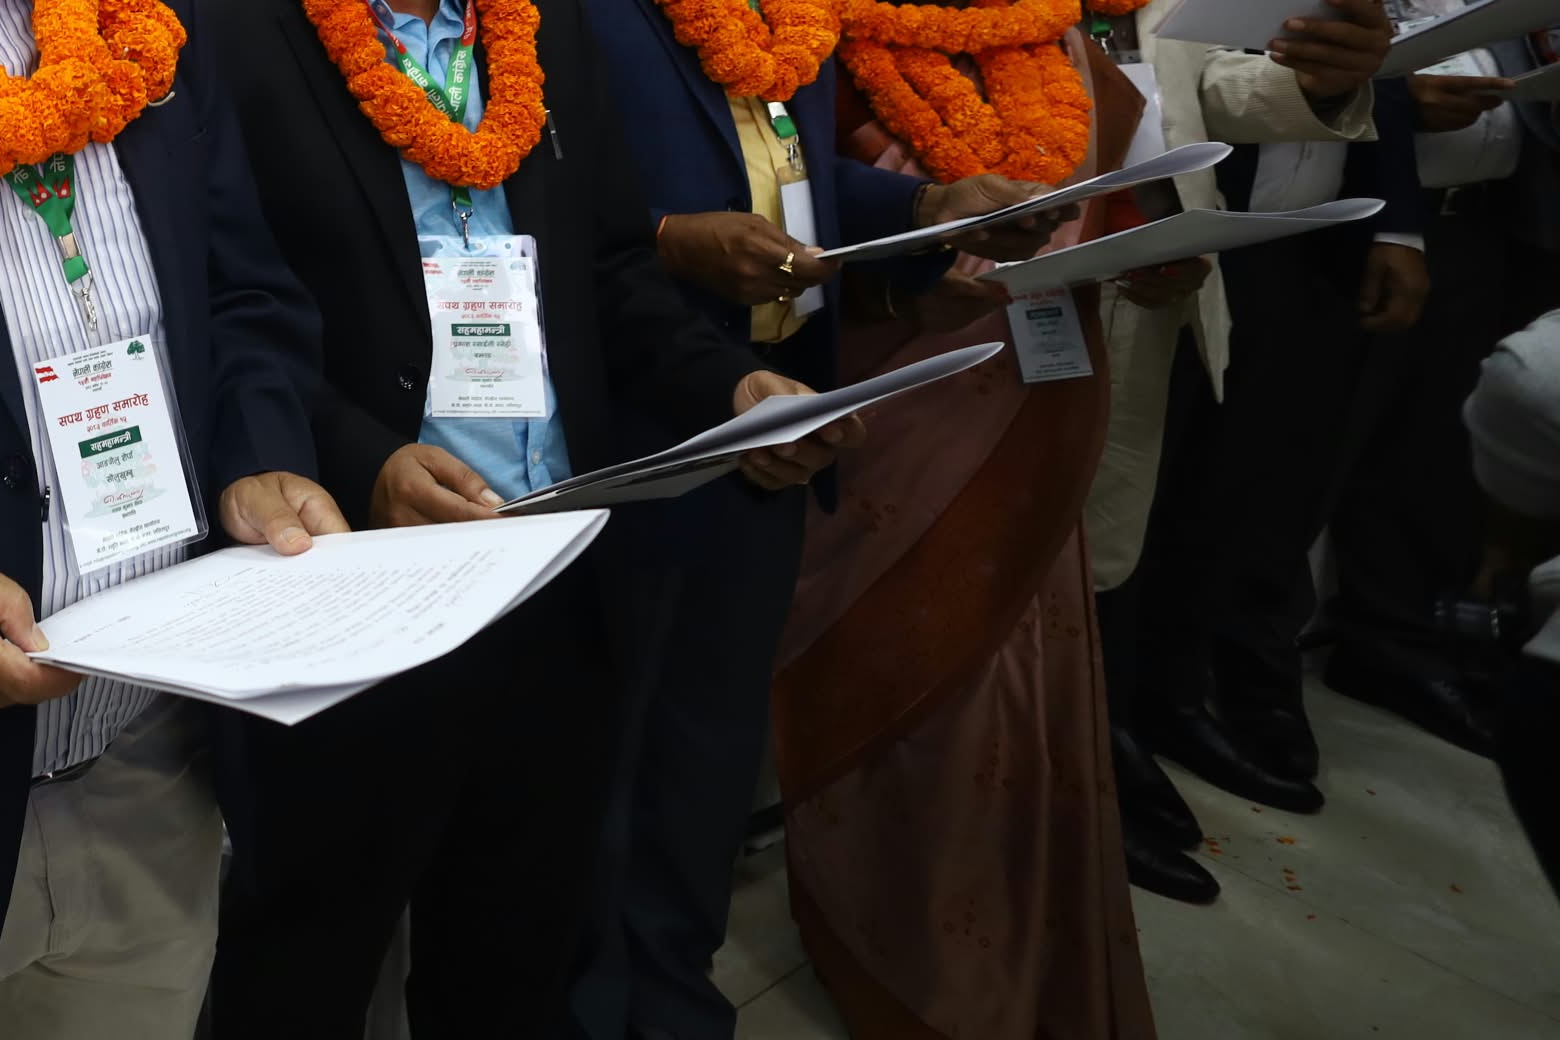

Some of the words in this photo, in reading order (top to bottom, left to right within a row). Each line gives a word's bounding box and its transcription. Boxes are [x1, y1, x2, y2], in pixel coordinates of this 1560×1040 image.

[58, 411, 83, 427] सपथ
[85, 404, 110, 421] ग्रहण
[112, 393, 149, 411] समारोह
